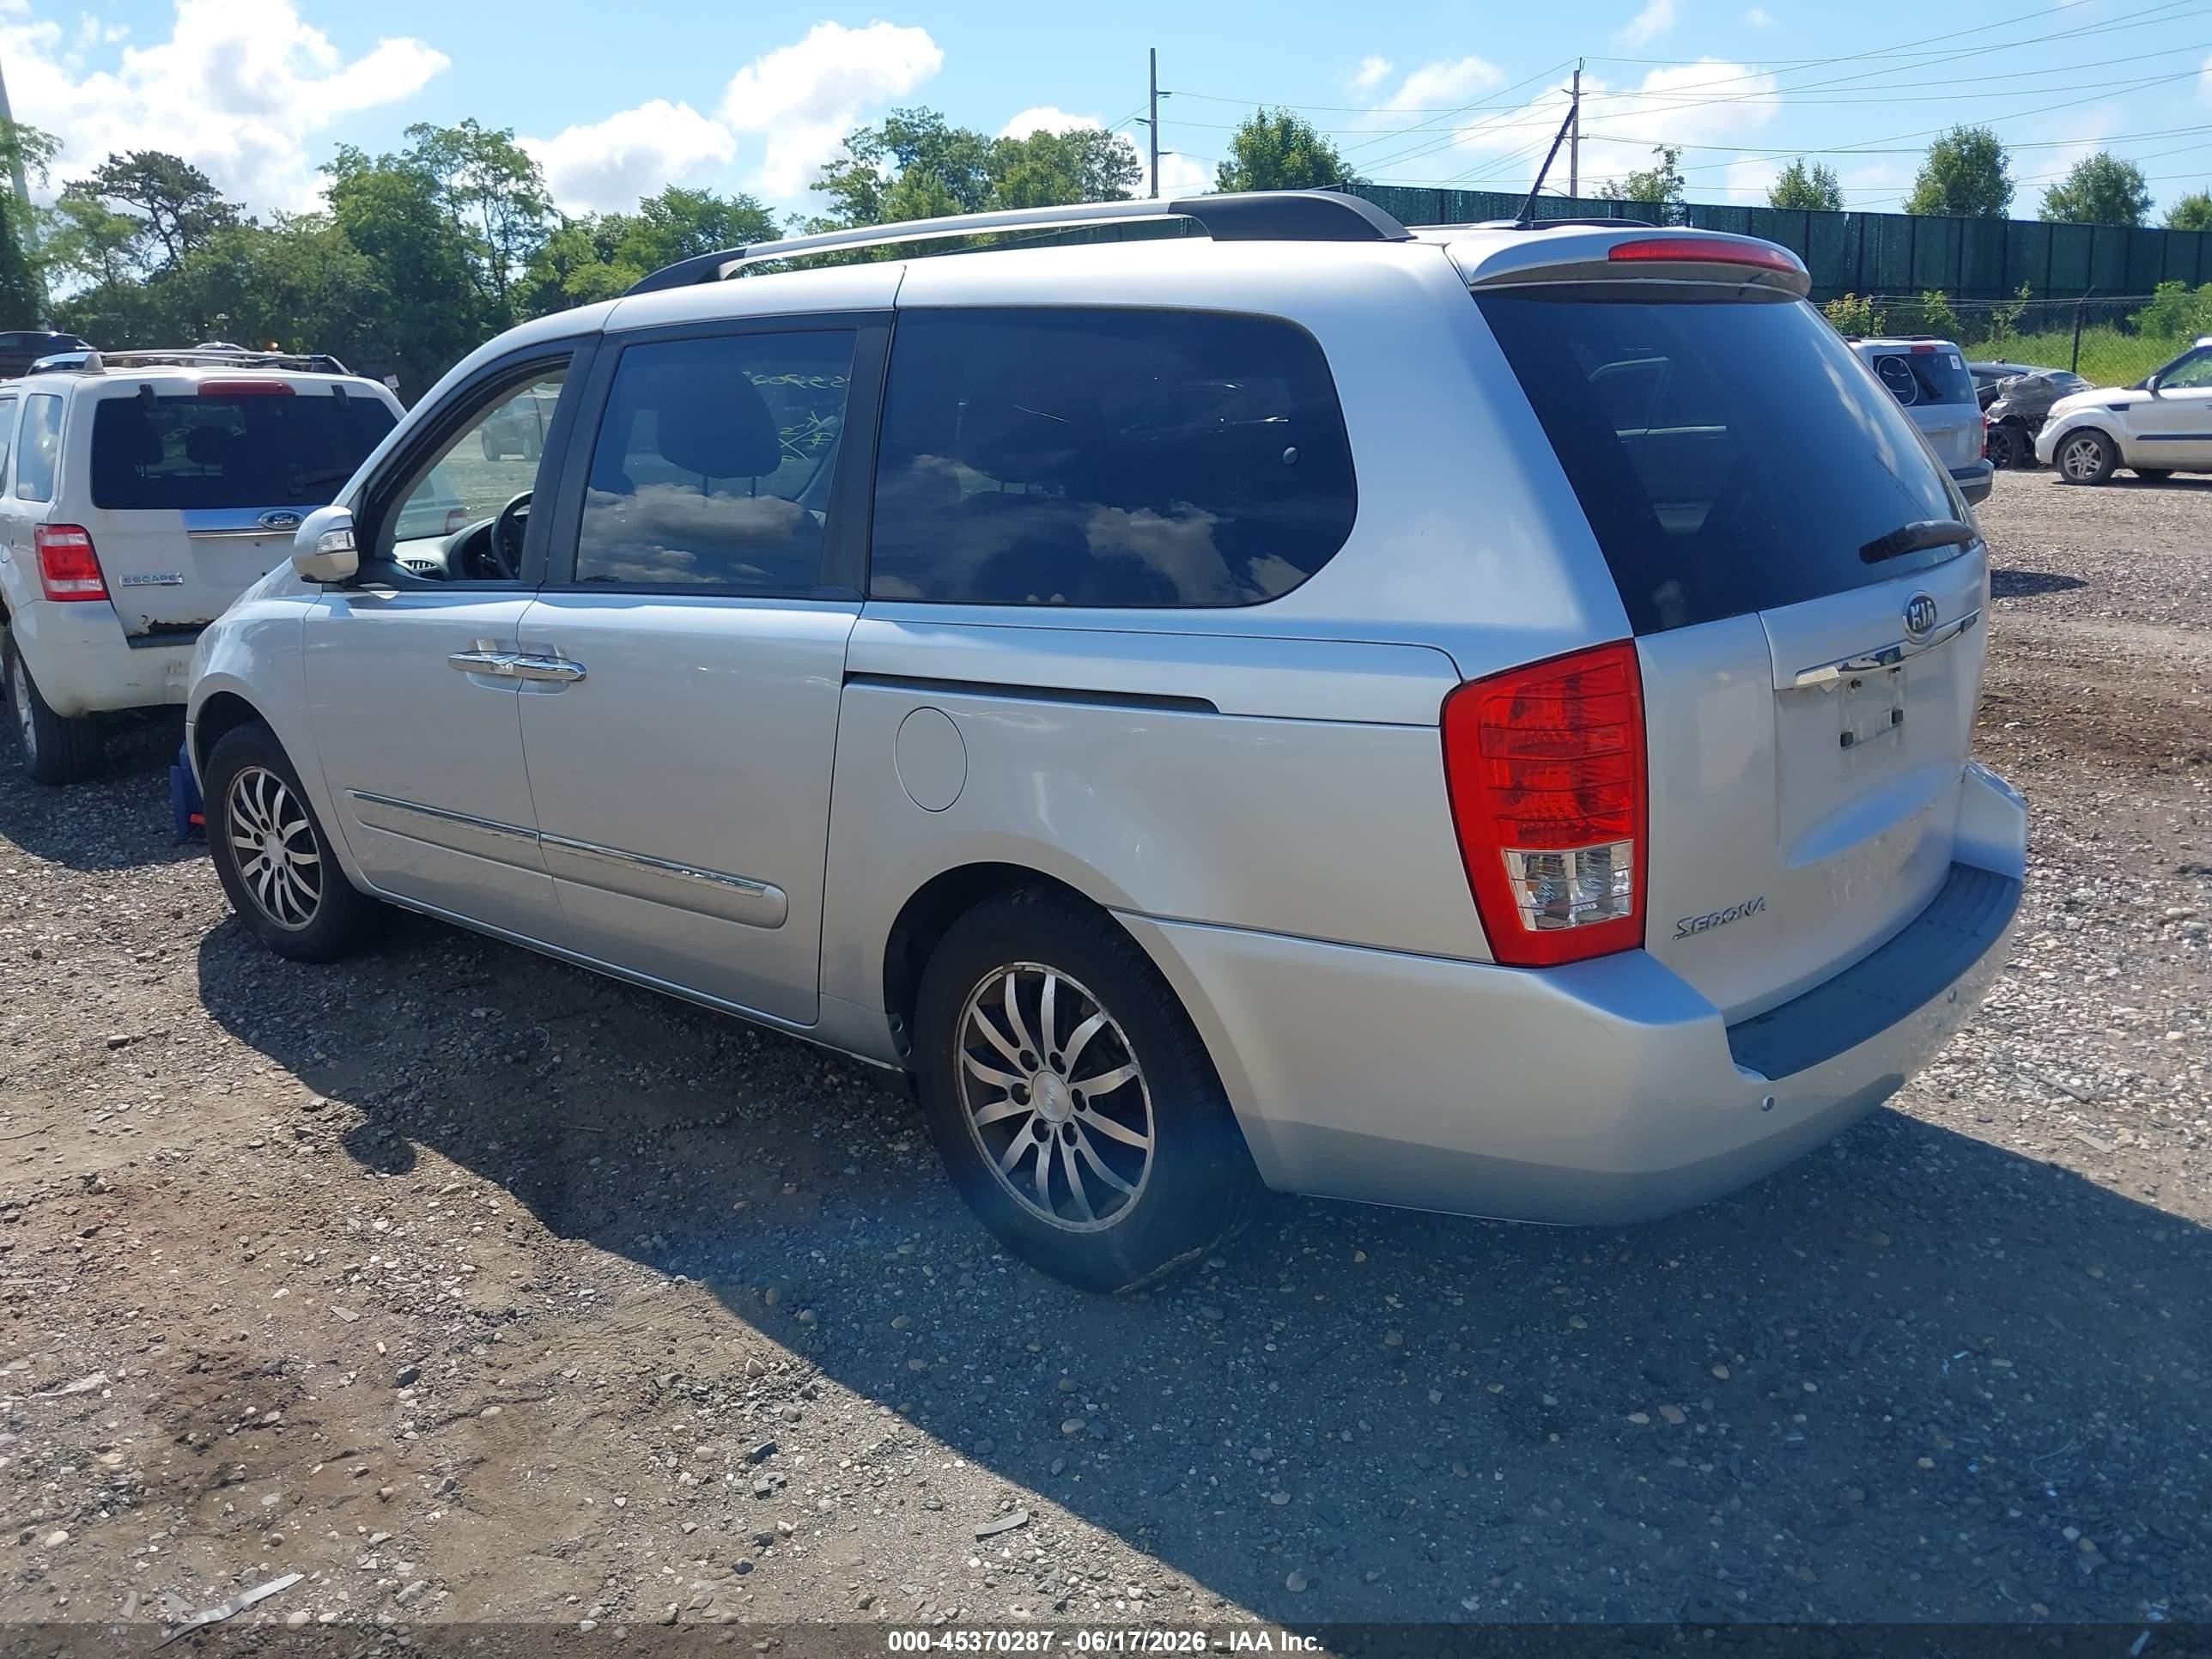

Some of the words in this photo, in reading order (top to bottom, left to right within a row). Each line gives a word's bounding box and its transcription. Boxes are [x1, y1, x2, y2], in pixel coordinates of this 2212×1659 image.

[273, 514, 295, 525] Ford
[123, 574, 179, 584] ESCAPE
[1911, 600, 1934, 630] KIA
[1673, 896, 1765, 940] SEDONA
